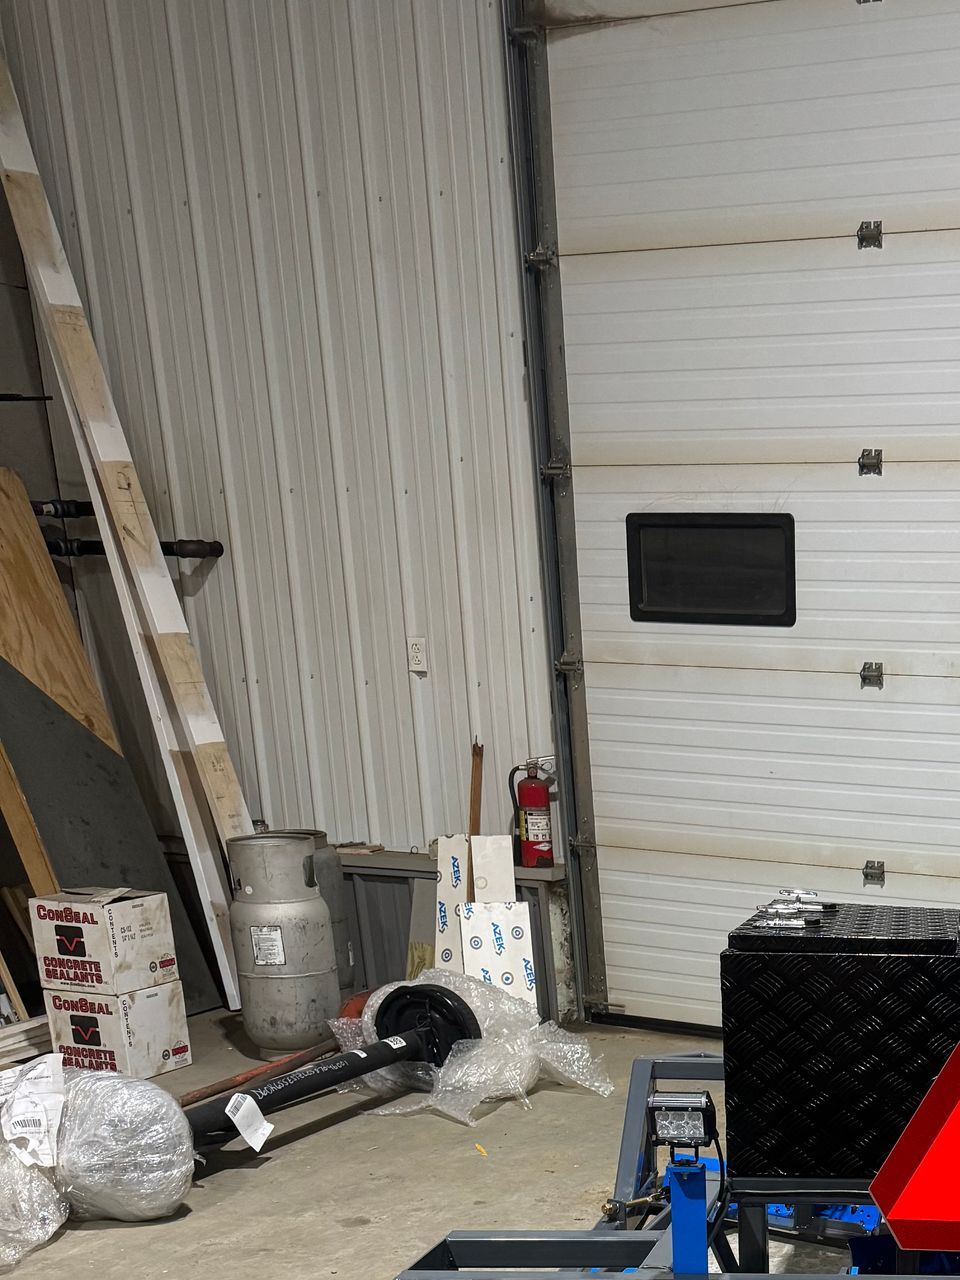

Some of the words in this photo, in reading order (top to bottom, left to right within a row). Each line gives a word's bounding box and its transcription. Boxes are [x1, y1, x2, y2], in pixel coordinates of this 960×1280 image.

[451, 856, 462, 884] AZEK
[438, 901, 448, 930] AZEK
[107, 908, 119, 958] CONTENTS
[491, 922, 506, 951] AZEK
[43, 956, 101, 973] CONCRETE
[45, 967, 103, 985] SEALANTS
[122, 999, 133, 1048] CONTENTS
[58, 1044, 116, 1062] CONCRETE
